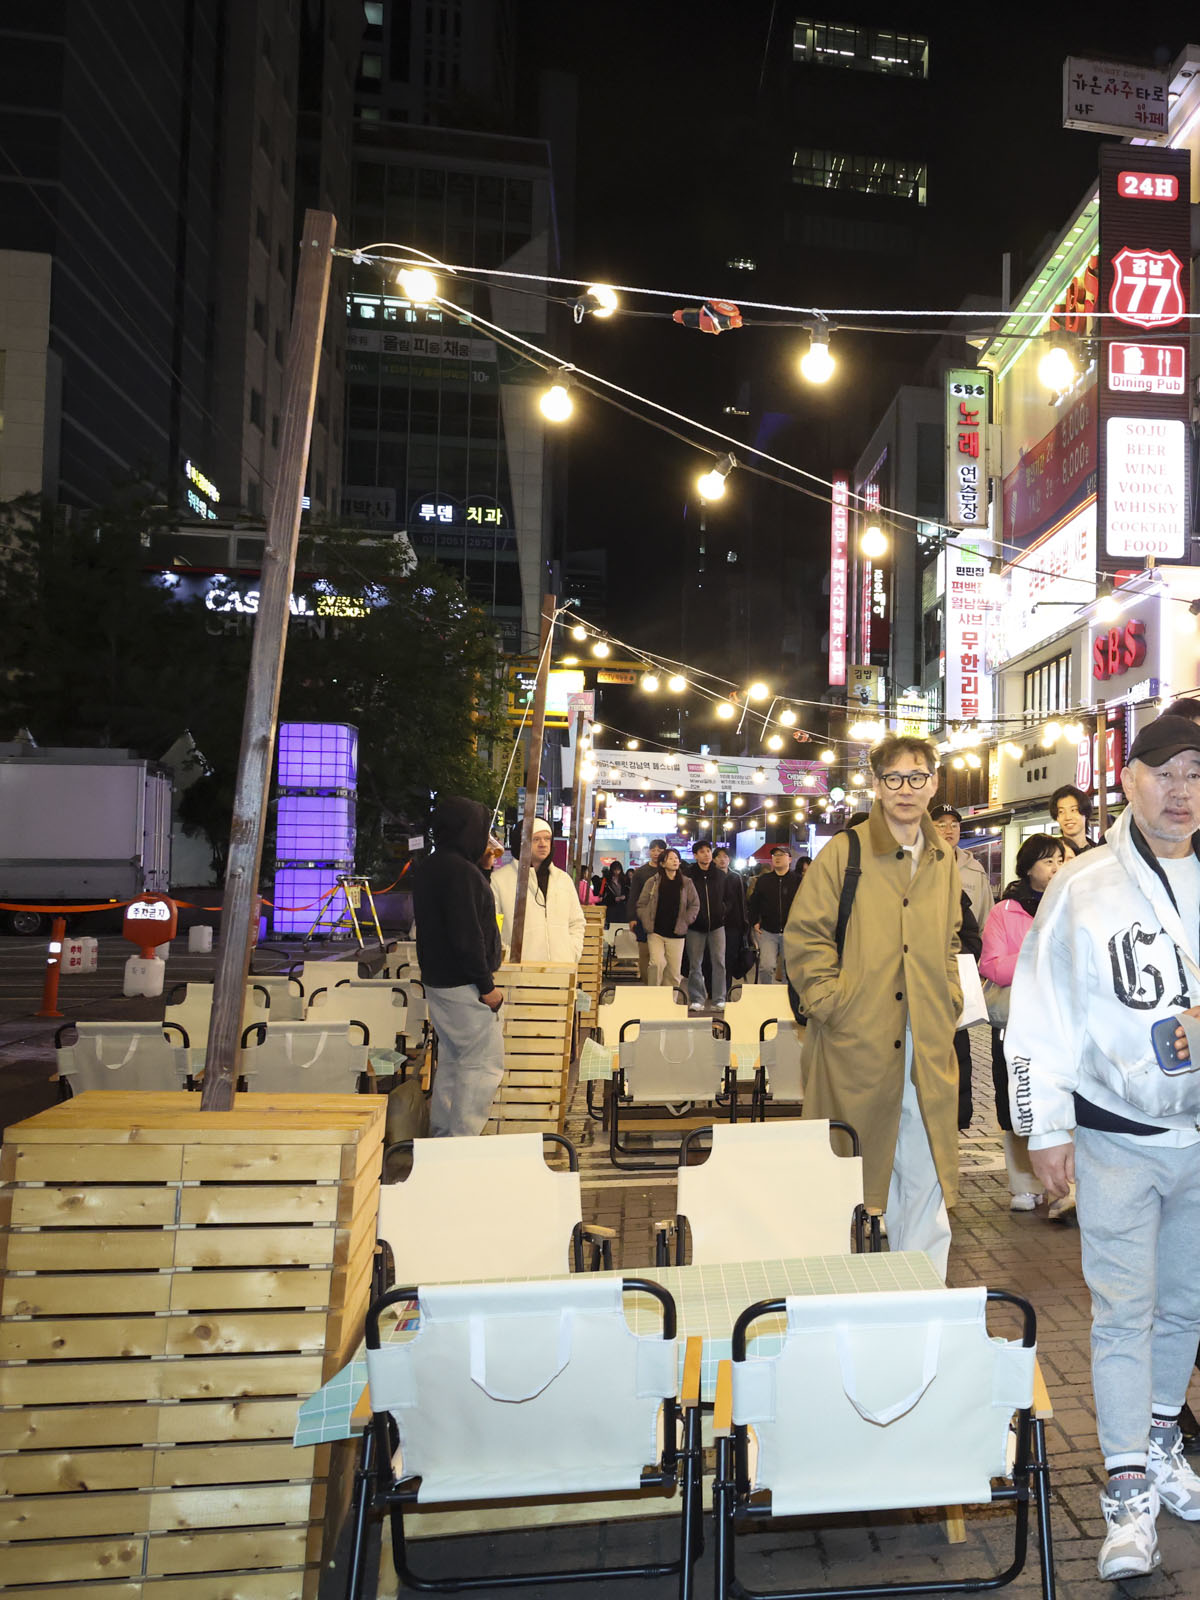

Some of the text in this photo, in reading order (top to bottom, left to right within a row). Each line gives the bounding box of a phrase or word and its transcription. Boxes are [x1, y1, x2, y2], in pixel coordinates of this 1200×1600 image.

[1071, 75, 1165, 102] 가온사주타로
[1074, 103, 1095, 116] 4F
[1134, 111, 1165, 126] 카페
[1124, 176, 1174, 198] 24H
[1132, 258, 1164, 277] 강남
[1123, 276, 1172, 315] 77
[953, 384, 985, 396] SBS
[1112, 376, 1181, 392] Dining Pub
[957, 402, 980, 459] 노래
[1126, 424, 1167, 438] SOJU
[1127, 443, 1166, 457] BEER
[1125, 463, 1168, 476] WINE
[959, 466, 979, 520] 연습장
[1118, 481, 1175, 496] VODCA
[418, 503, 503, 526] 루덴 치과
[1113, 501, 1179, 515] WHISKY
[1111, 521, 1182, 535] COCKTAIL
[1123, 540, 1169, 553] FOOD
[956, 566, 985, 578] 편편집
[873, 569, 887, 619] 준오헤어
[205, 589, 315, 616] CASAL
[958, 612, 984, 626] 샤브
[1093, 619, 1147, 681] SBS
[854, 669, 872, 680] 김밥
[960, 632, 980, 718] 무한리필
[132, 906, 166, 919] 주차금지
